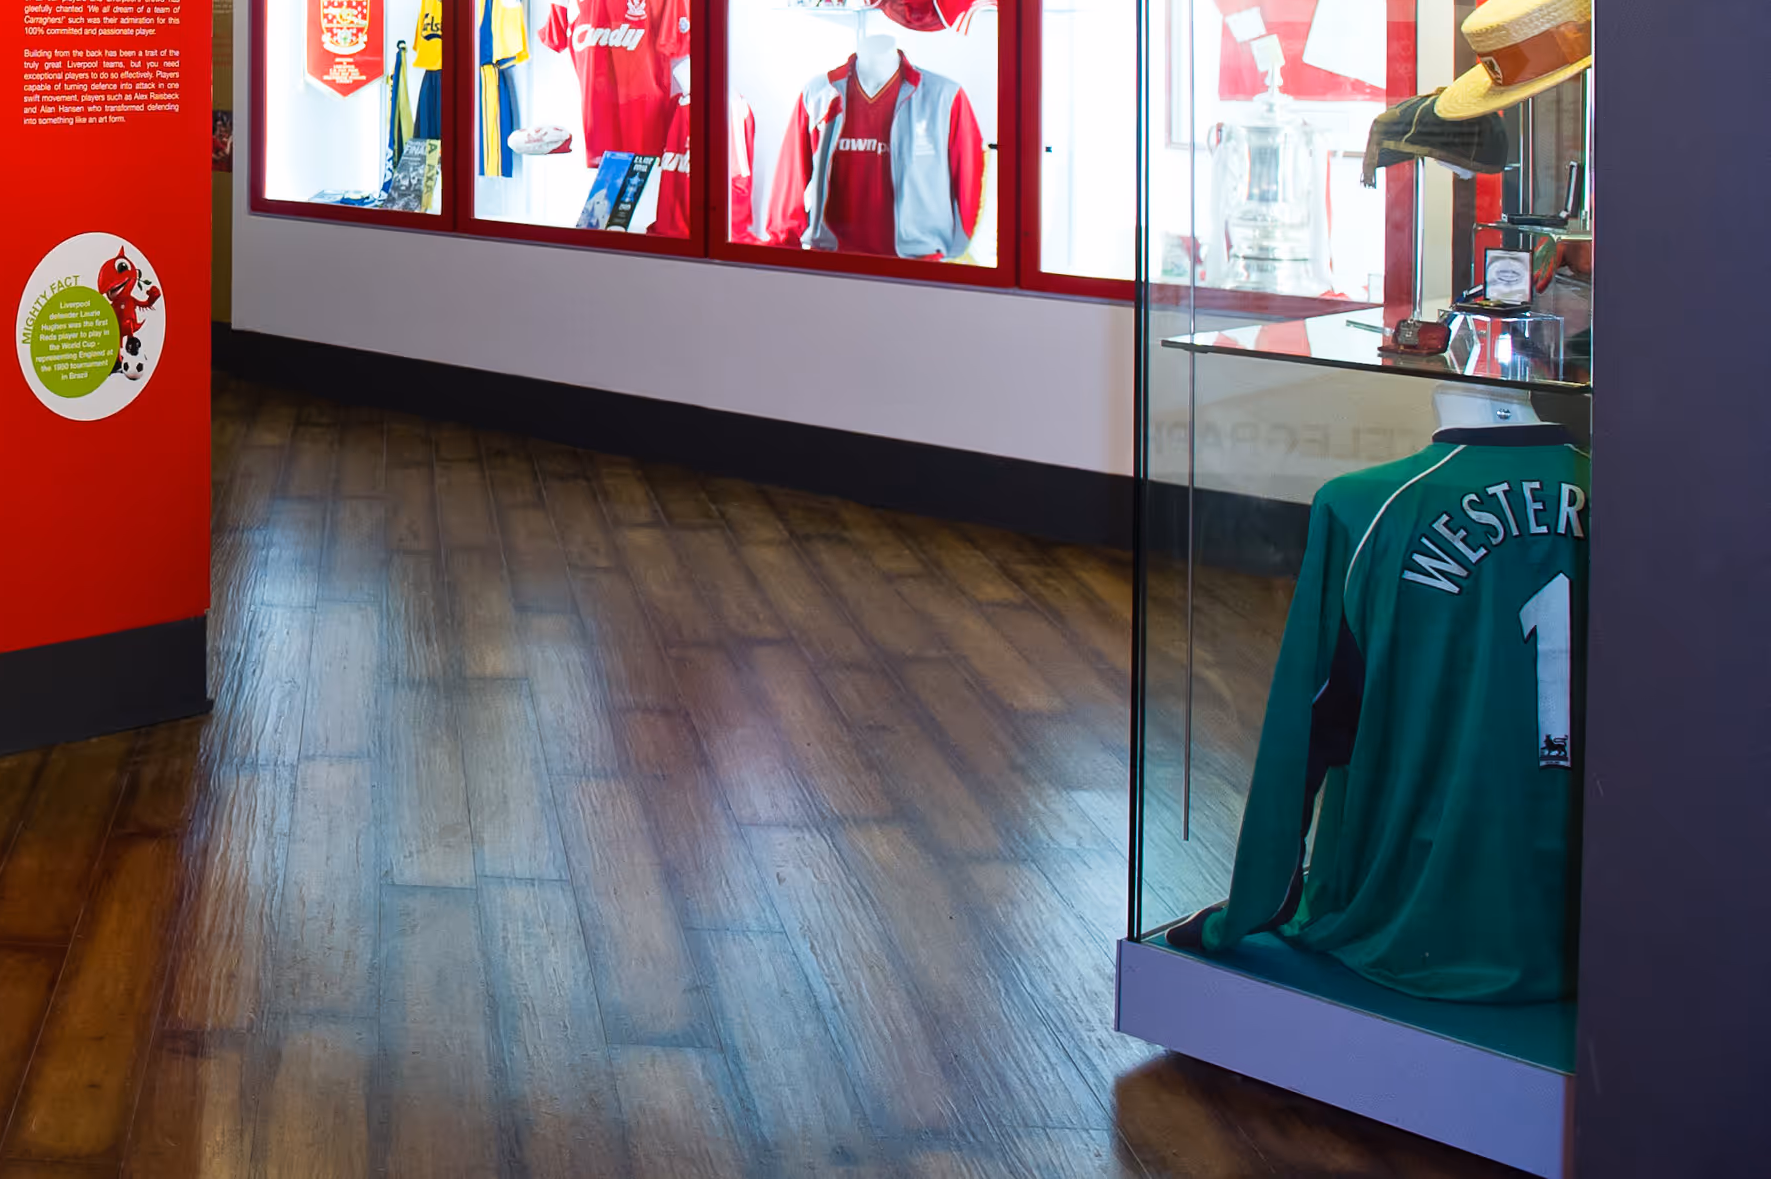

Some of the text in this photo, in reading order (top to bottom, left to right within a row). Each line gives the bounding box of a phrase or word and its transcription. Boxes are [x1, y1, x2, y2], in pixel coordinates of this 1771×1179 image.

[21, 275, 80, 345] MIGHTY FACT
[1402, 480, 1586, 595] WESTER
[1518, 571, 1571, 767] 1
